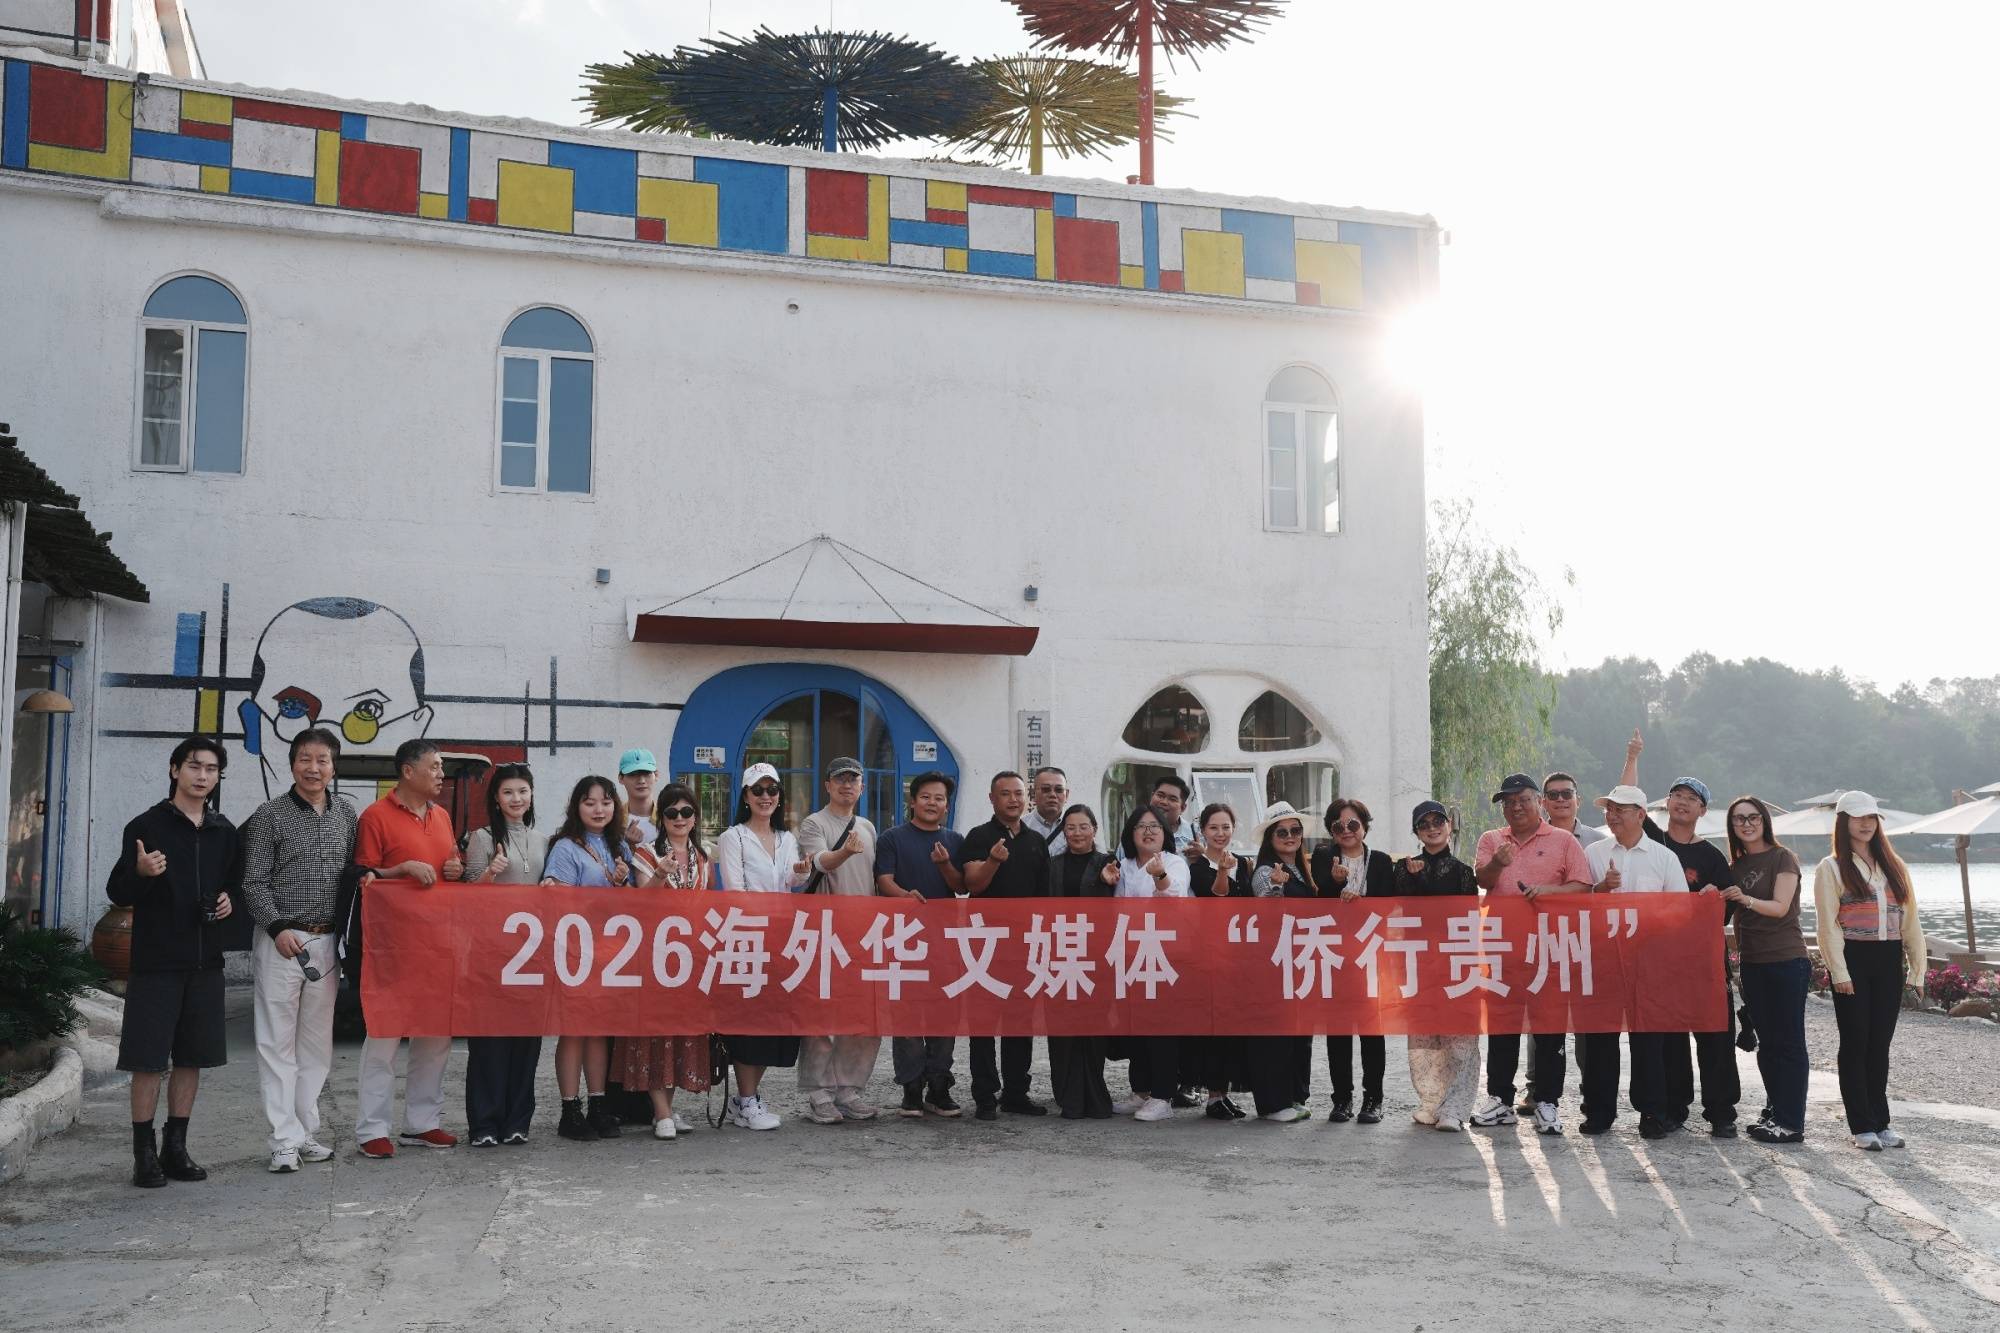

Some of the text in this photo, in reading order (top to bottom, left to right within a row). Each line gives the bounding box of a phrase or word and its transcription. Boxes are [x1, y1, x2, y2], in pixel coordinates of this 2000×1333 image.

[501, 907, 1638, 1001] 2026海外华文媒体 “侨行贵州”
